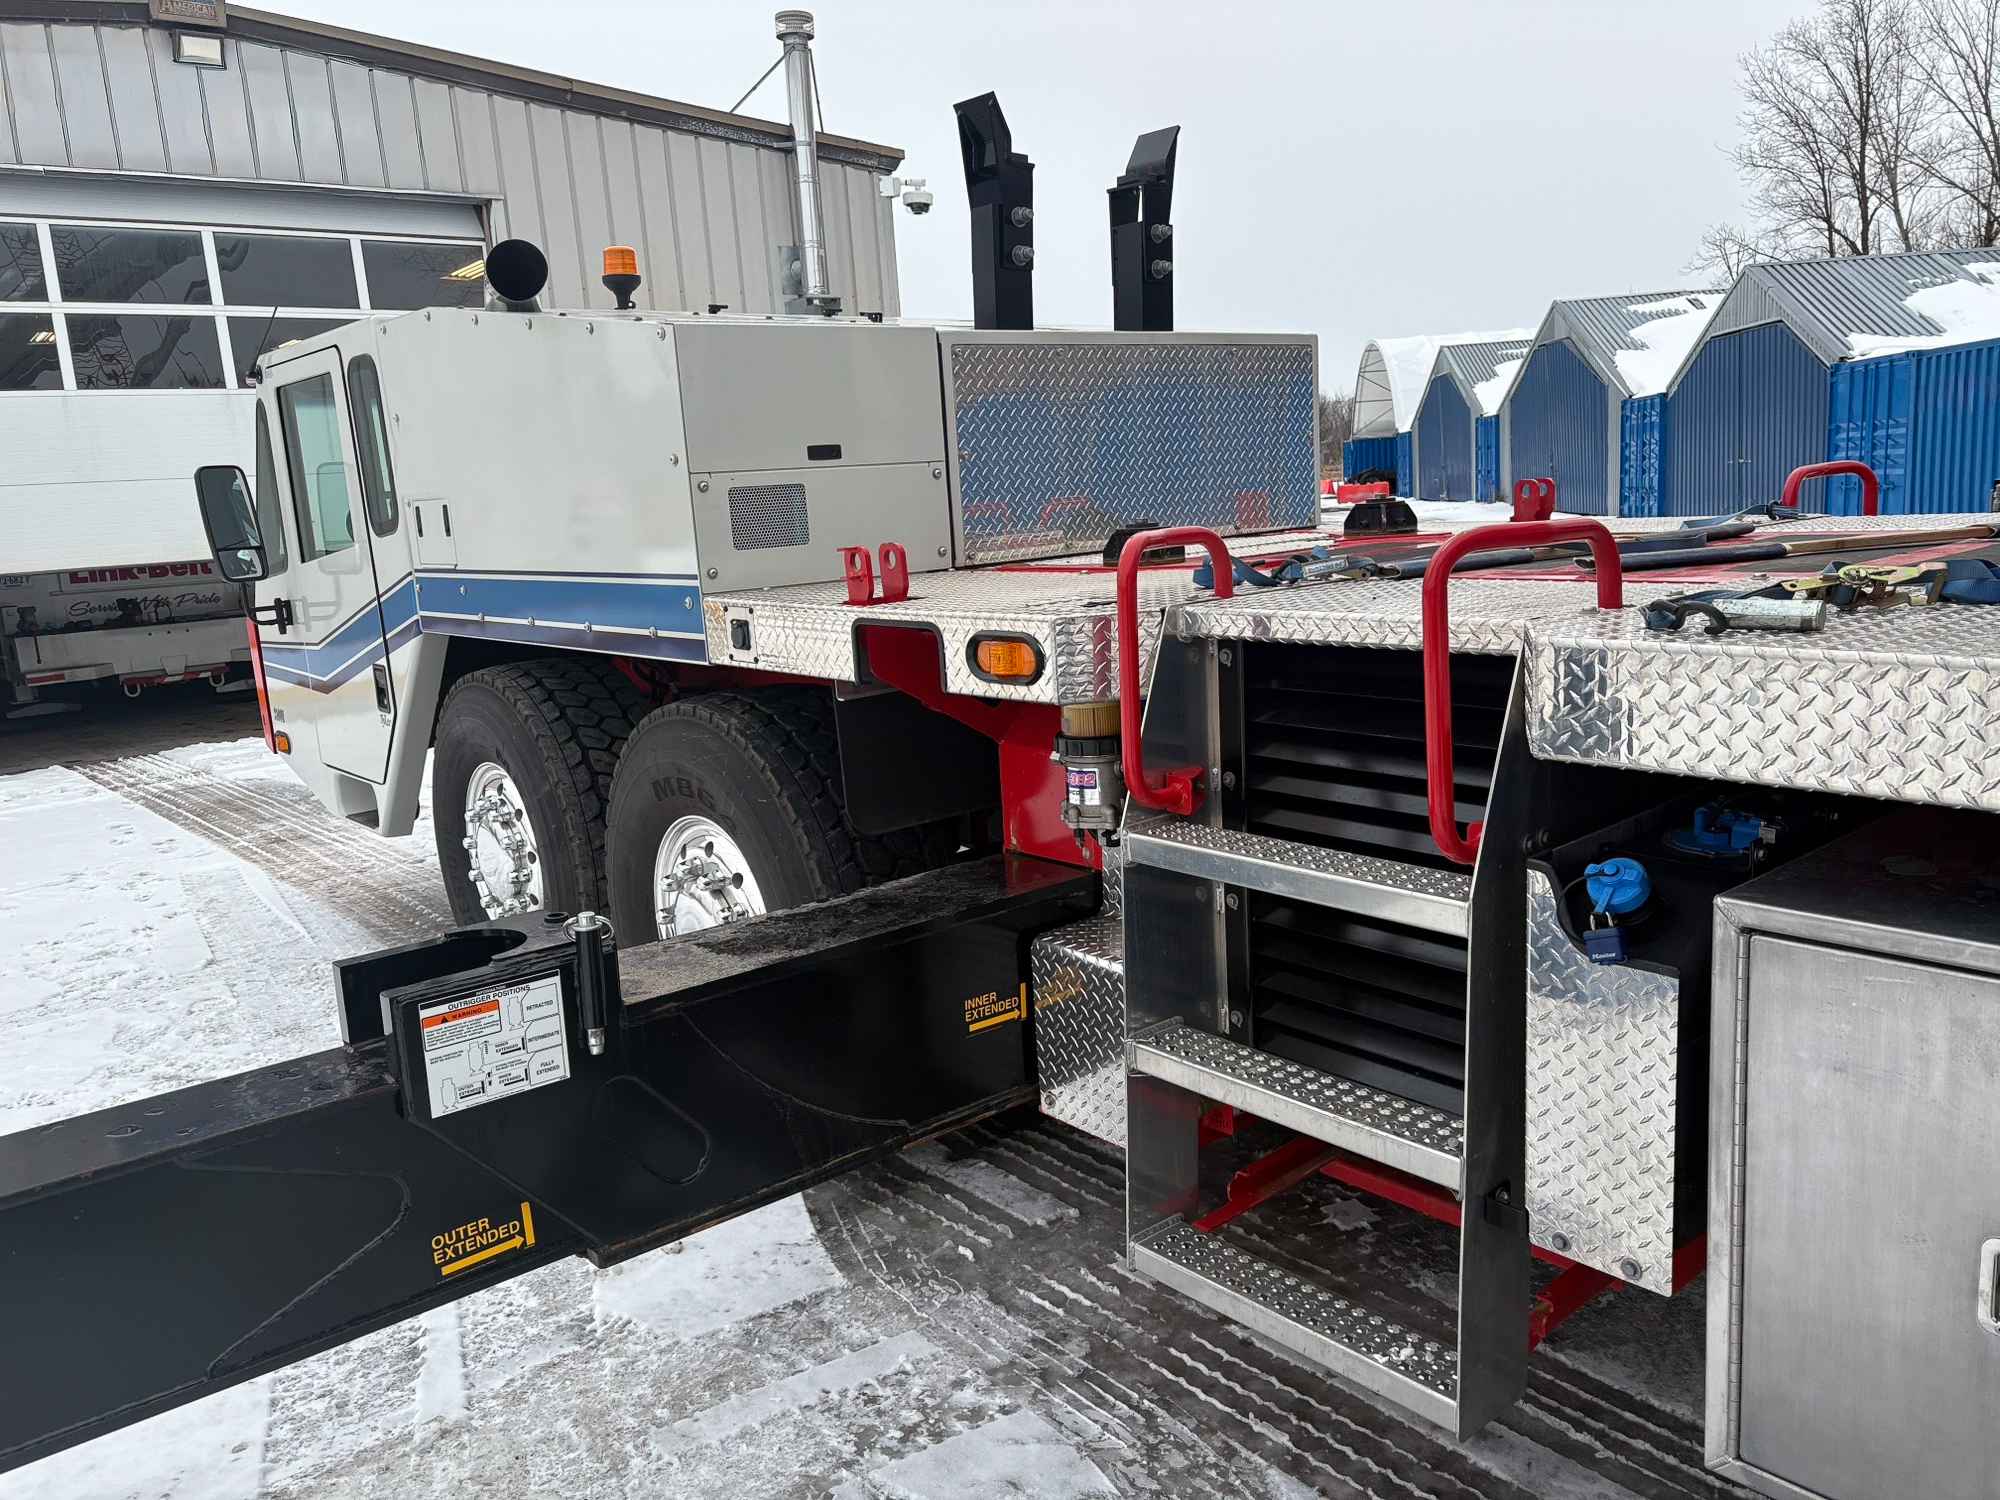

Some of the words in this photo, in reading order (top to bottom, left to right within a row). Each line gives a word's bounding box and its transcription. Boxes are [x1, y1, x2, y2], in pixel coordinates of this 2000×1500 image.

[172, 591, 222, 608] Pride
[447, 994, 491, 1011] OUTRIGGER
[492, 984, 531, 999] POSITIONS
[964, 991, 997, 1010] INNER
[526, 1000, 554, 1012] RETRACTED
[965, 996, 1019, 1022] EXTENDED
[452, 1008, 482, 1020] WARNING
[495, 1043, 519, 1053] EXTENDED
[536, 1065, 561, 1076] EXTENDED
[540, 1060, 554, 1069] FULLY
[458, 1087, 483, 1097] EXTENDED
[431, 1217, 490, 1250] OUTER
[433, 1220, 521, 1265] EXTENDED
